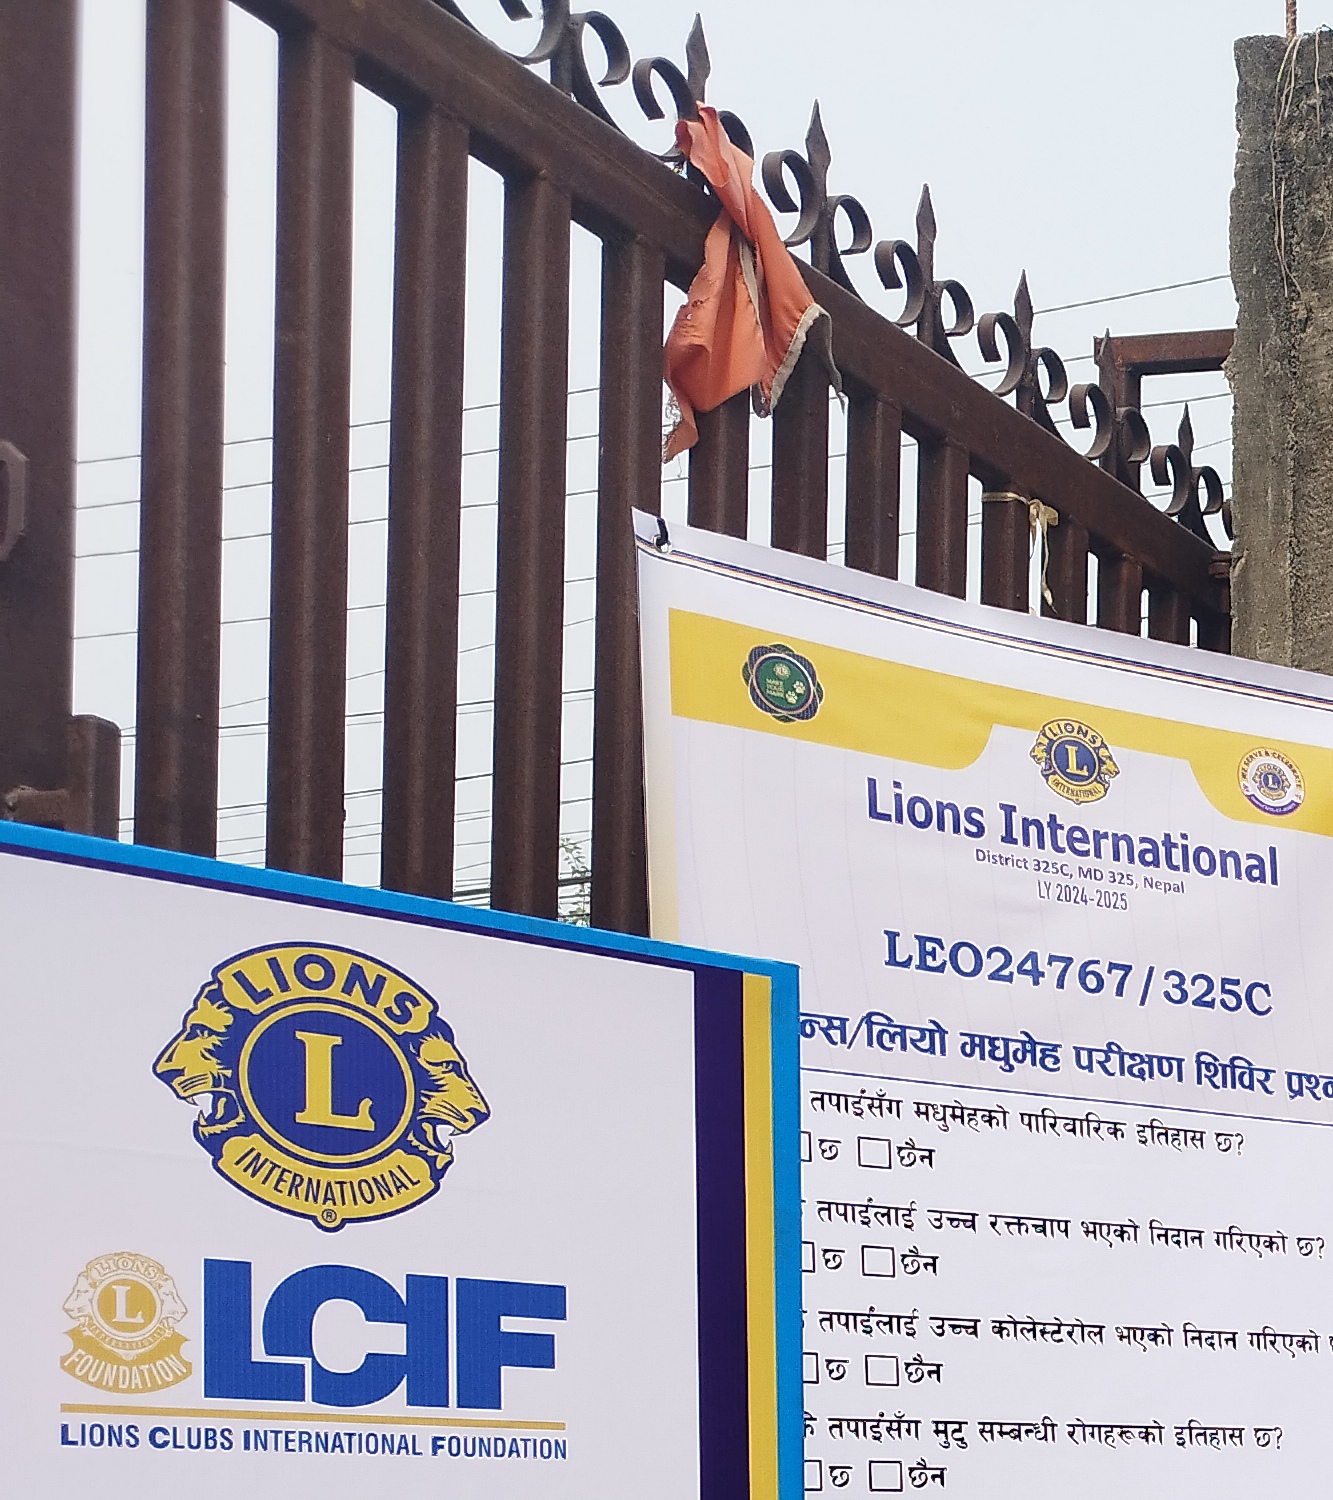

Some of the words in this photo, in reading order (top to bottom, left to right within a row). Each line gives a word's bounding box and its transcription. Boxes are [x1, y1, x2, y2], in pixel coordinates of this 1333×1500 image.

[1050, 722, 1101, 746] LIONS
[1064, 744, 1090, 777] L
[1050, 777, 1102, 800] INTERNATIONAL
[867, 776, 986, 841] Lions
[1000, 804, 1280, 887] International
[975, 846, 1029, 872] District
[1031, 857, 1074, 882] 325C,
[1078, 864, 1106, 883] MD
[1108, 870, 1139, 891] 325,
[1144, 876, 1186, 898] Nepal
[1038, 880, 1052, 903] LY
[1053, 884, 1129, 912] 2024-2025
[231, 953, 422, 1026] LIONS
[884, 929, 1273, 1018] LEO24767/325C
[295, 1030, 375, 1131] L
[960, 1031, 1062, 1072] मधुमेह
[1073, 1041, 1185, 1083] परीक्षण
[1195, 1051, 1276, 1095] शिविर
[913, 1100, 1010, 1133] मधुमेहको
[1019, 1108, 1126, 1141] पारिवारिक
[1136, 1119, 1206, 1152] इतिहास
[1215, 1132, 1245, 1156] छ?
[896, 1138, 935, 1169] छैन
[234, 1146, 421, 1206] INTERNATIONAL
[927, 1209, 979, 1234] उच्च
[988, 1214, 1071, 1239] रक्तचाप
[1081, 1219, 1140, 1248] भएको
[1149, 1219, 1204, 1249] निदान
[1213, 1226, 1288, 1258] गरिएको
[93, 1256, 158, 1280] LIONS
[112, 1285, 144, 1323] L
[204, 1258, 567, 1410] LCIF
[990, 1314, 1106, 1344] कोलेस्टेरोल
[63, 1348, 187, 1390] FOUNDATION
[60, 1422, 141, 1451] LIONS
[147, 1426, 234, 1454] CLUBS
[242, 1427, 424, 1457] INTERNATIONAL
[430, 1434, 568, 1461] FOUNDATION
[932, 1419, 968, 1449] मुटु
[978, 1416, 1058, 1443] सम्बन्धी
[1066, 1417, 1165, 1450] रोगहरूको
